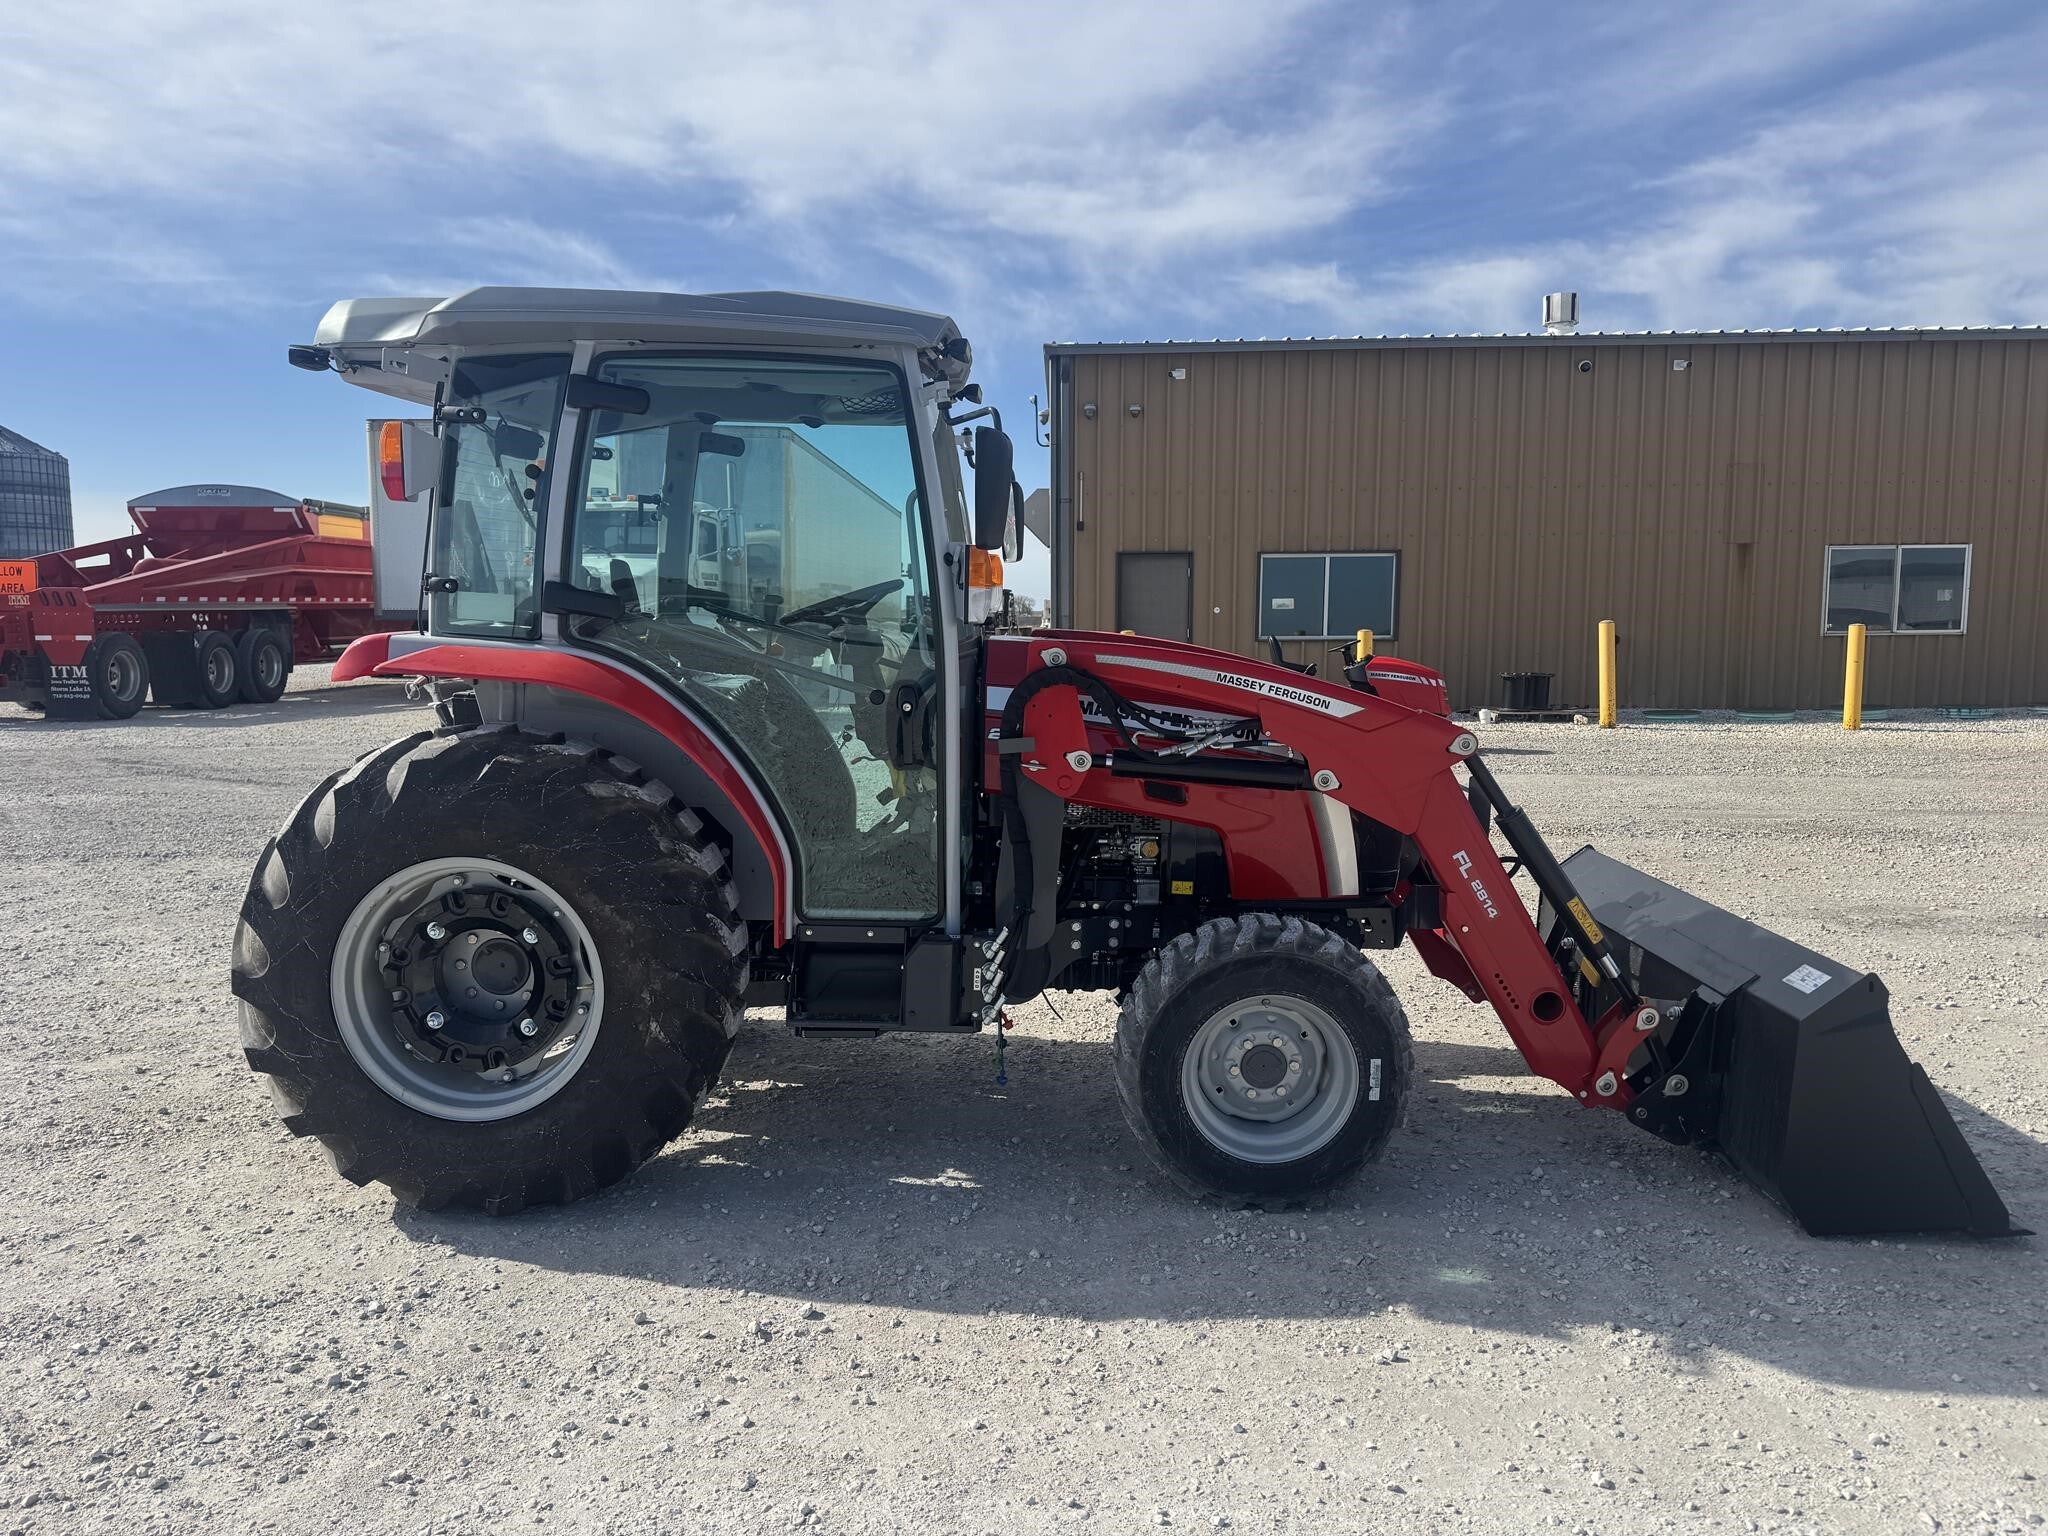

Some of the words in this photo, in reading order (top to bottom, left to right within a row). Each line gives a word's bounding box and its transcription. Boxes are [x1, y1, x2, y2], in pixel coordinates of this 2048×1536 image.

[1, 583, 25, 593] AREA
[50, 665, 88, 678] ITM
[1390, 673, 1417, 681] FERGUSON
[1216, 673, 1266, 691] MASSEY
[1267, 685, 1331, 710] FERGUSON
[1452, 849, 1473, 879] FL
[1470, 879, 1498, 919] 2814
